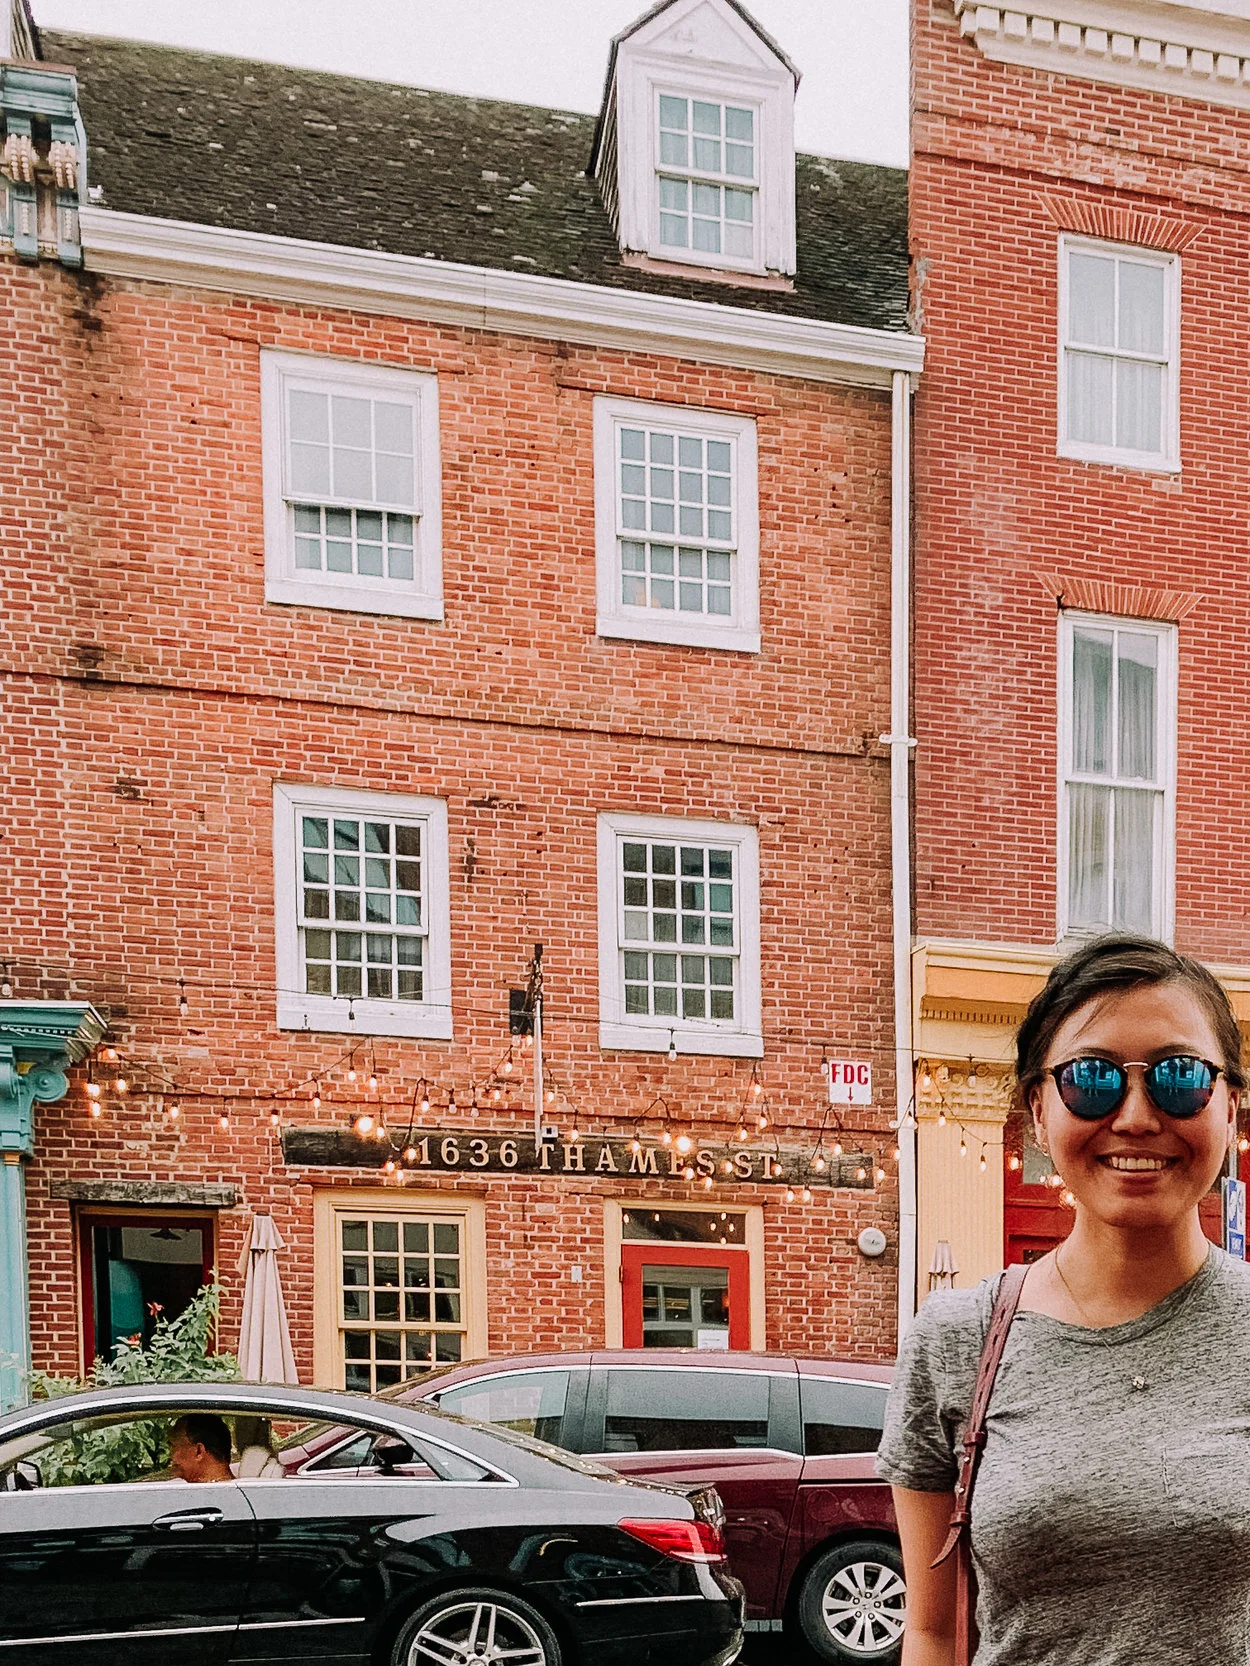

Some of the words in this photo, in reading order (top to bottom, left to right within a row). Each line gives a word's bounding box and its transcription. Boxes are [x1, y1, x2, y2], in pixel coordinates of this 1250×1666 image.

[831, 1063, 869, 1085] FDC
[418, 1136, 519, 1168] 1636
[537, 1143, 715, 1178] THAMES
[734, 1151, 777, 1180] ST
